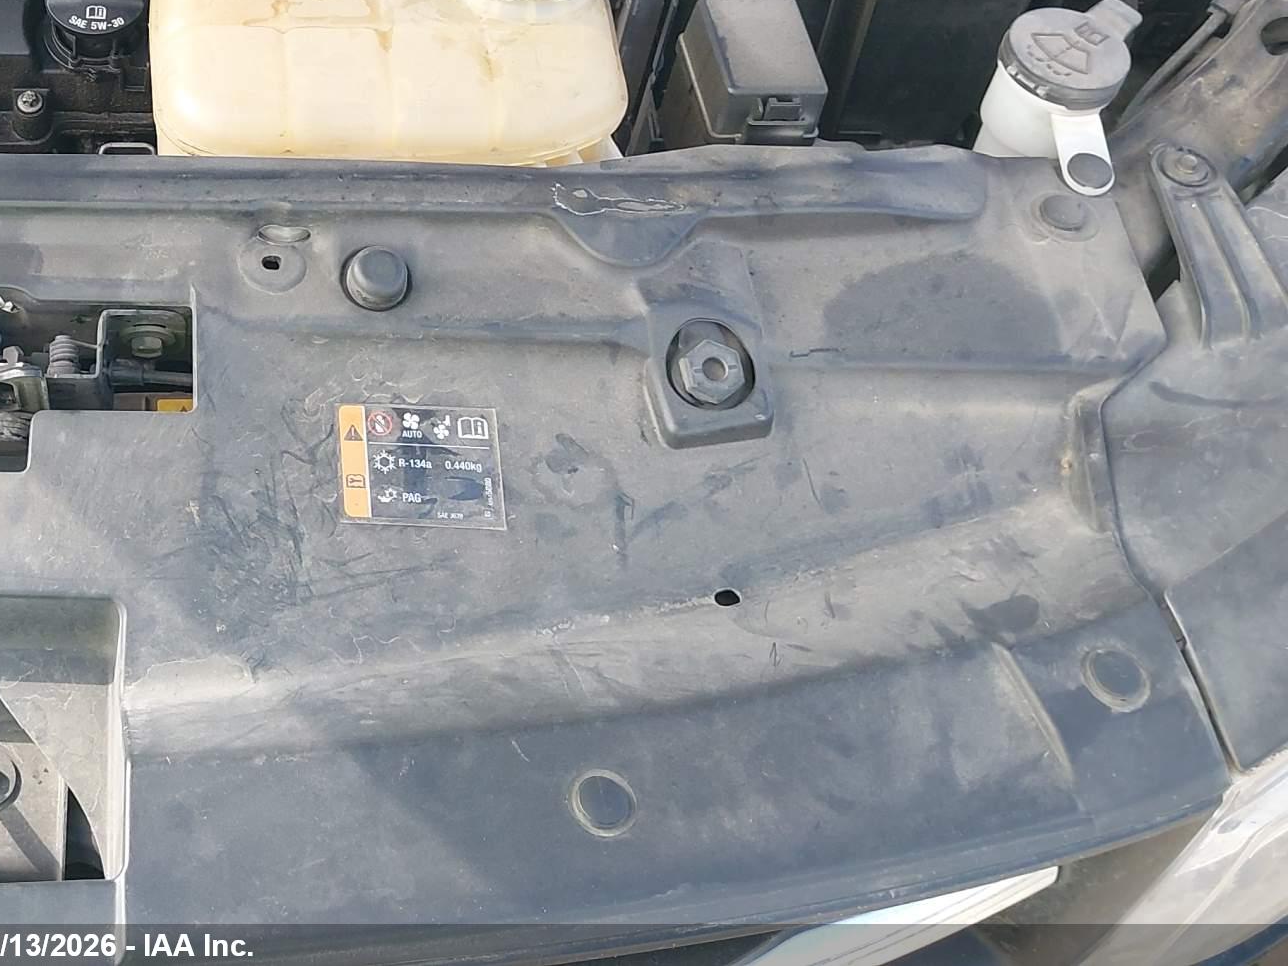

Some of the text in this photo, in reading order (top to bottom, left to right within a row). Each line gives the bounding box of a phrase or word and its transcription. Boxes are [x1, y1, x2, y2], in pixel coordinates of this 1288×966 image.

[68, 15, 125, 30] SAE 5W-30
[402, 430, 422, 438] AUTO
[398, 459, 482, 473] R-134a 0.440kg
[402, 493, 422, 503] PAG
